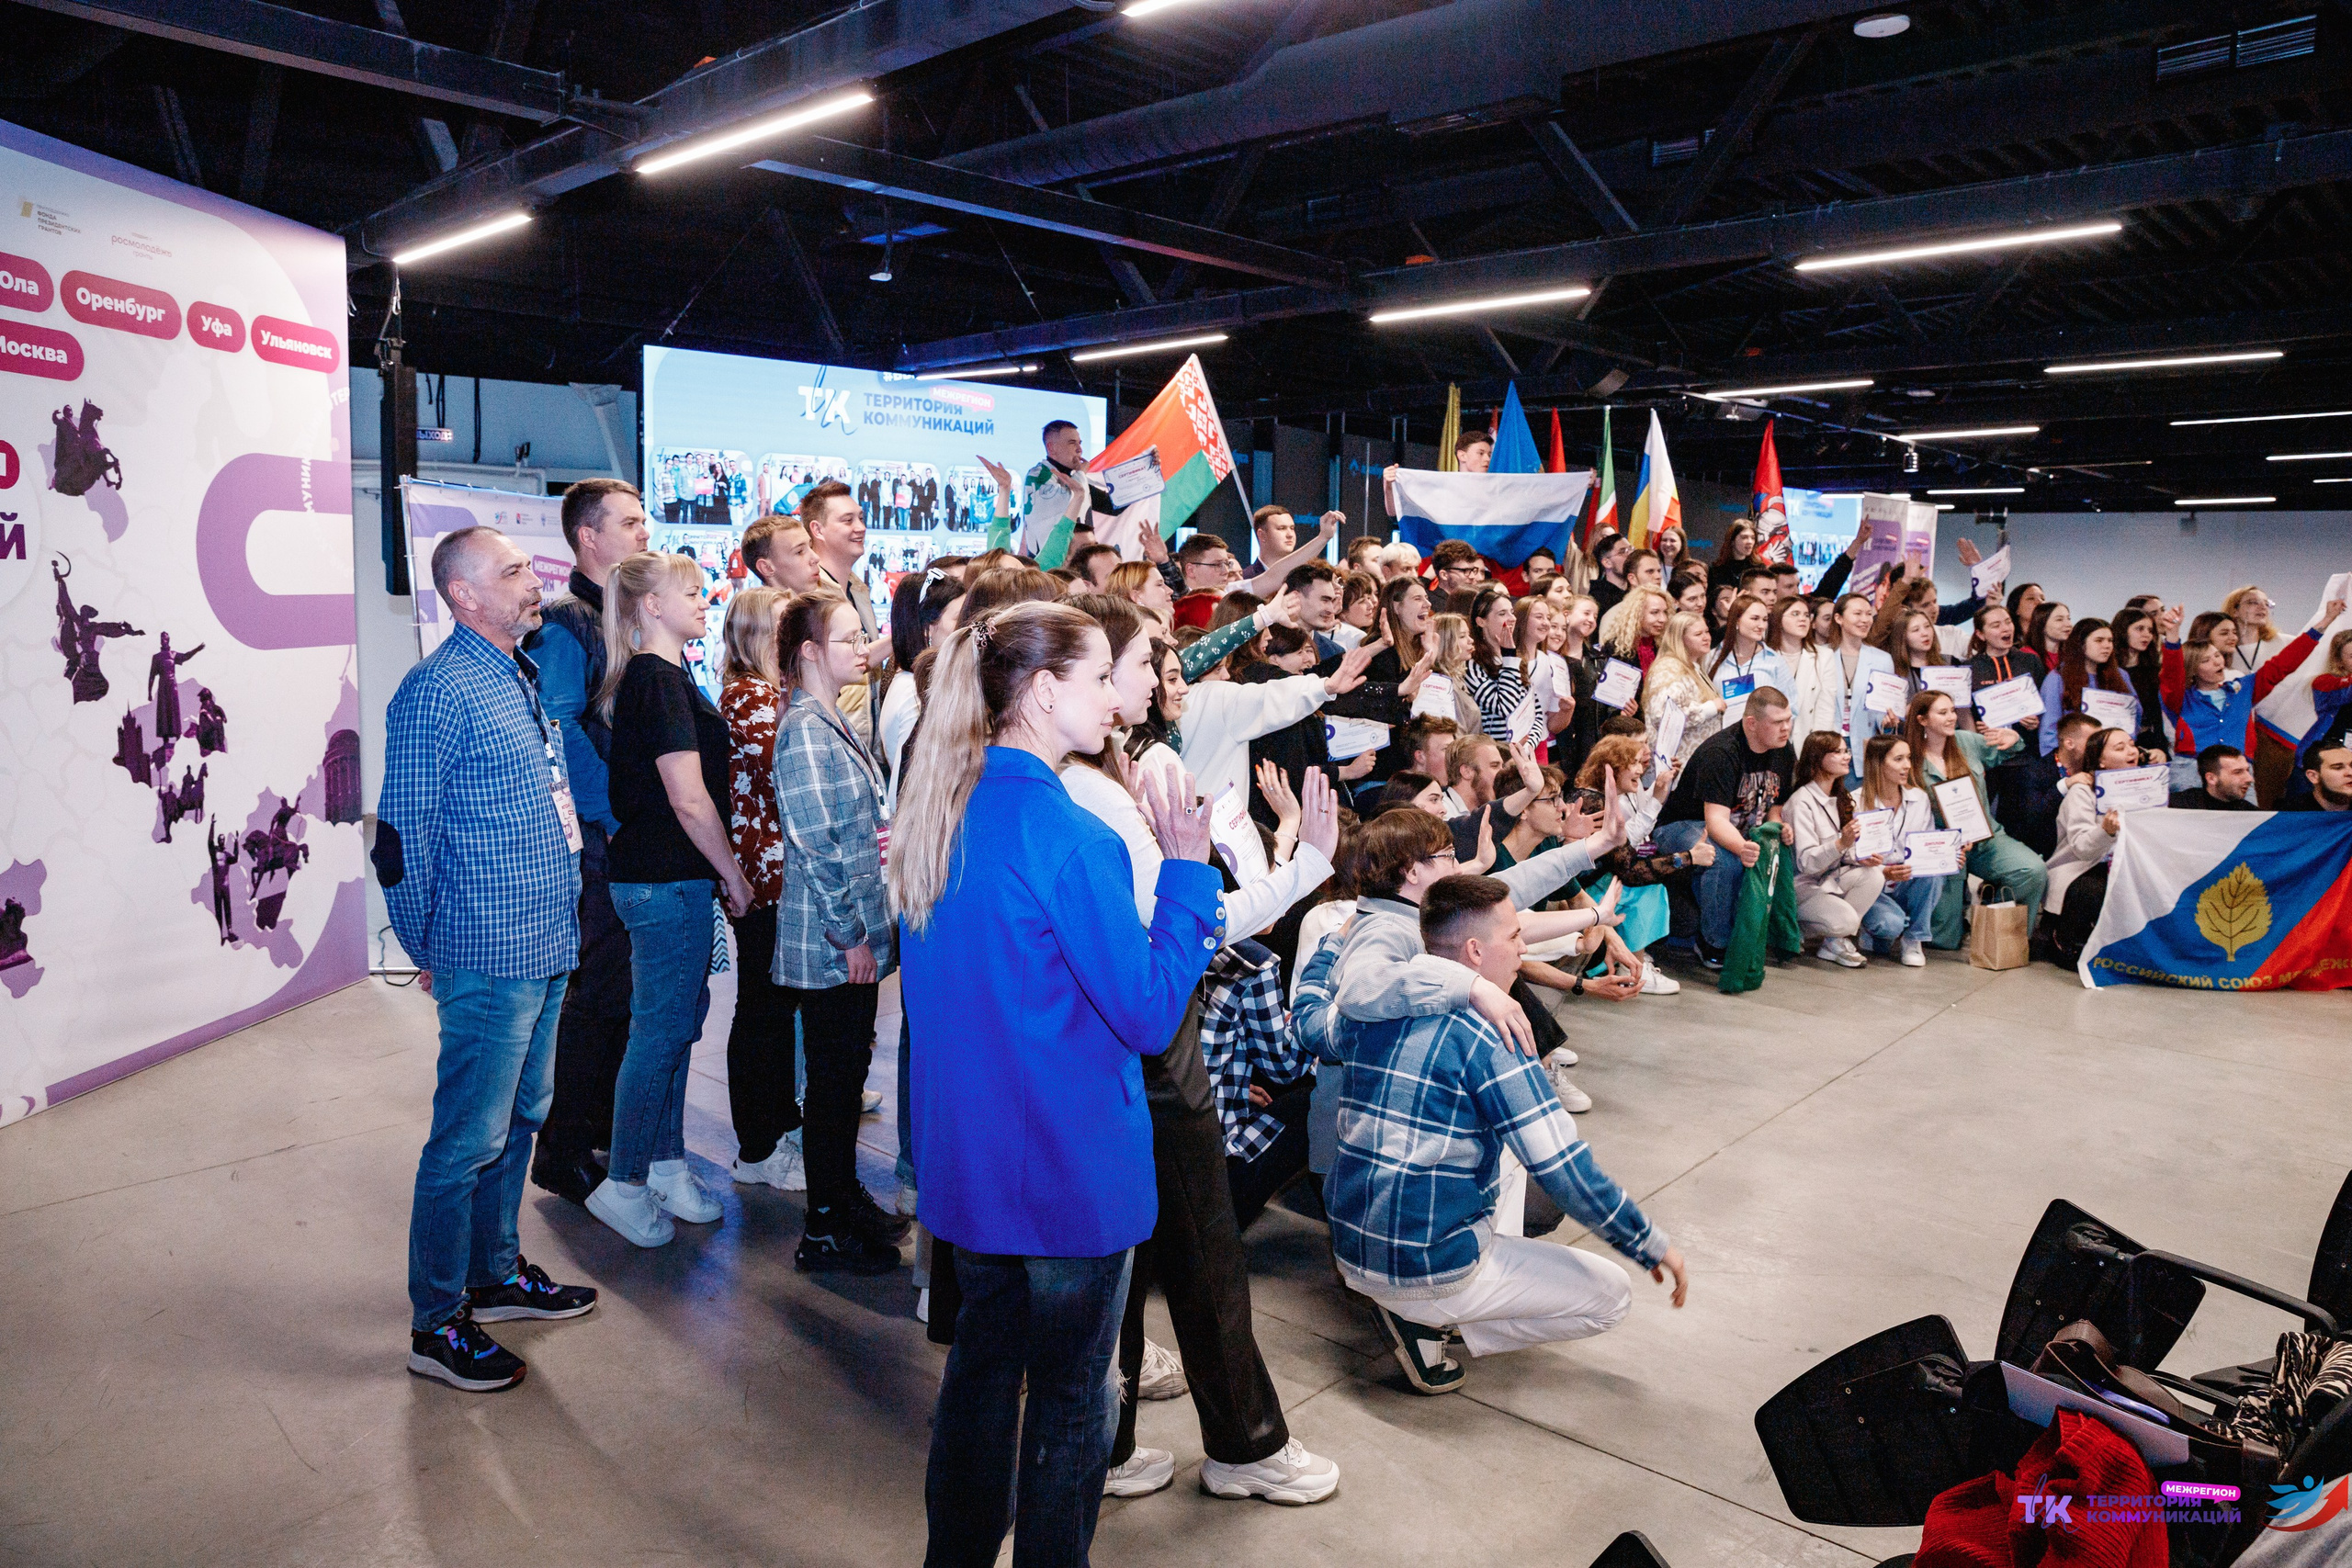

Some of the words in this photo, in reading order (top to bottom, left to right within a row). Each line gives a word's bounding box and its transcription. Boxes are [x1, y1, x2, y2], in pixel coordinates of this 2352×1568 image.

[76, 287, 165, 322] Оренбург
[201, 315, 233, 338] Уфа
[260, 329, 333, 360] Ульяновск
[864, 392, 963, 415] ТЕРРИТОРИЯ
[933, 387, 991, 408] МЕЖРЕГИОН
[864, 411, 995, 435] КОММУНИКАЦИЙ
[2093, 957, 2213, 988] РОССИЙСКИЙ
[2218, 976, 2273, 989] СОЮЗ
